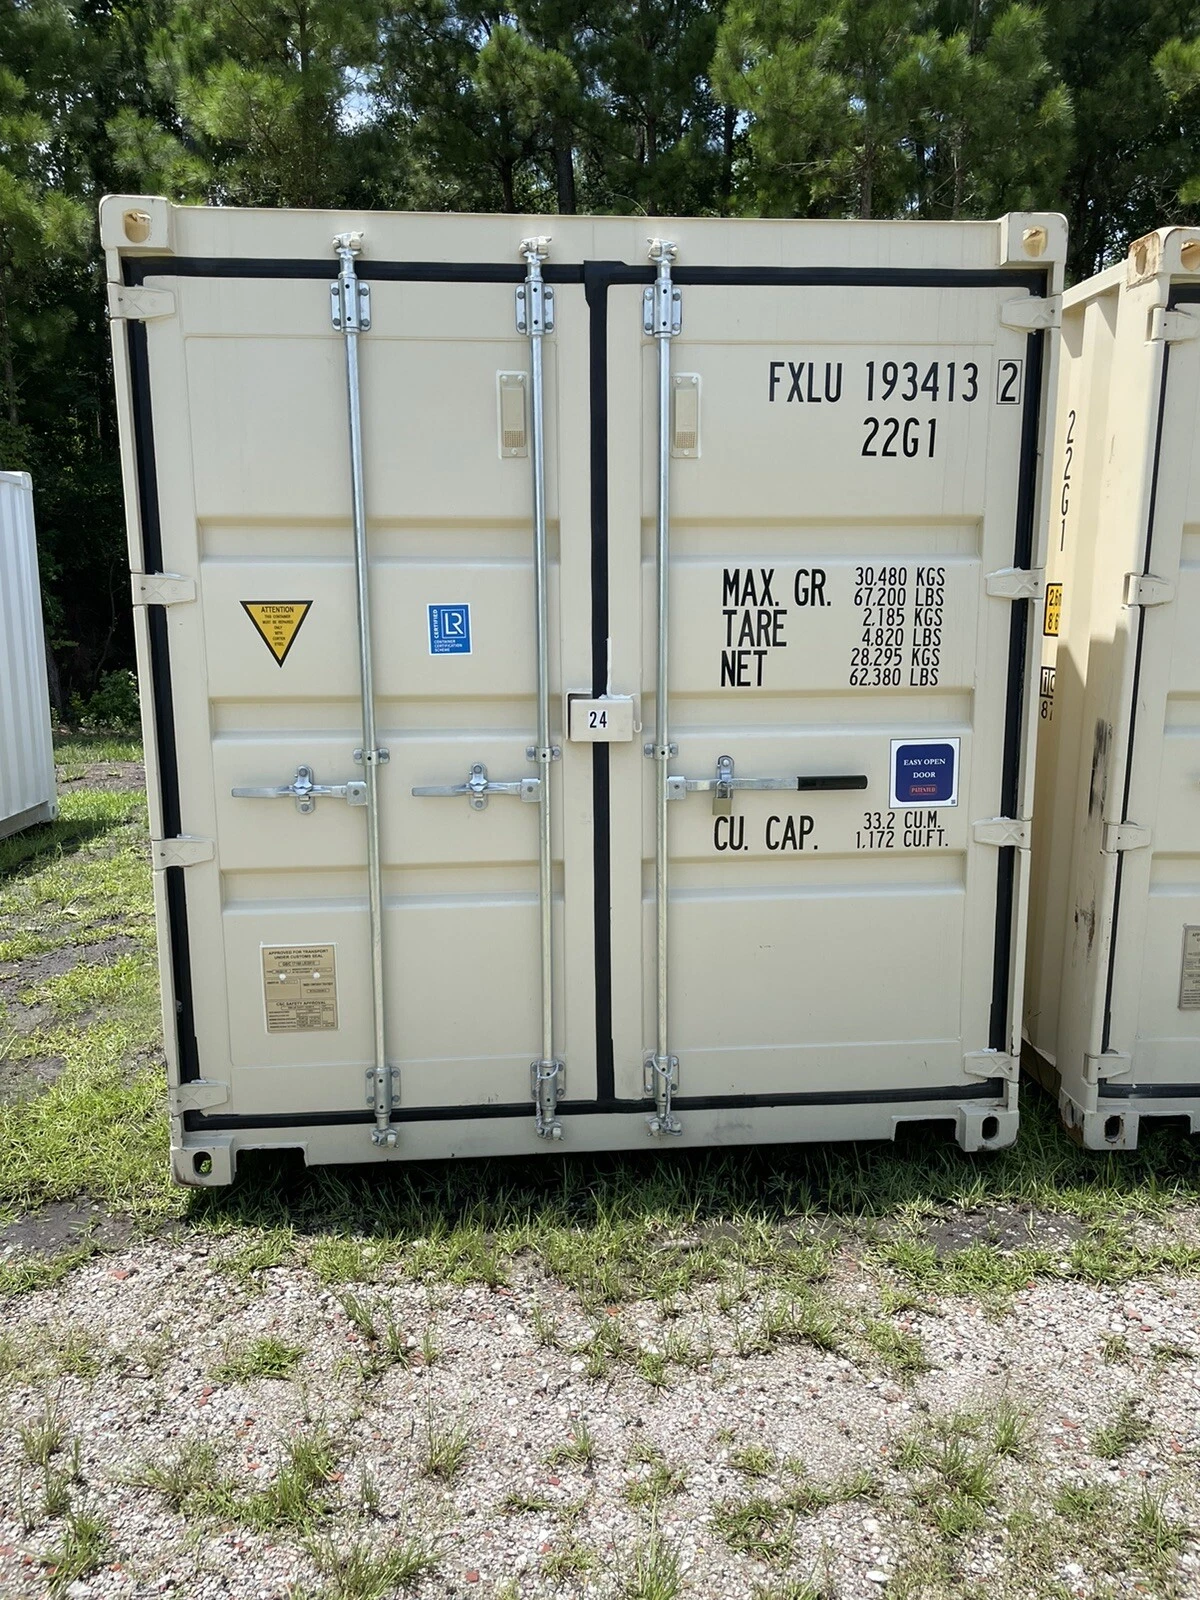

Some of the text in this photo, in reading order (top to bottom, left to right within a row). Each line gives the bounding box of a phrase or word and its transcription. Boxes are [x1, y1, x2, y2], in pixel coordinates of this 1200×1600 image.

[769, 361, 1018, 402] FXLU 193413 2
[861, 416, 936, 458] 22G1
[1061, 410, 1075, 551] 22G1
[916, 567, 945, 586] KGS
[722, 568, 831, 607] MAX. GR.
[915, 587, 944, 607] LBS
[445, 612, 464, 635] LR
[914, 608, 943, 627] KGS
[722, 610, 787, 647] TARE
[913, 628, 942, 647] LBS
[911, 648, 940, 667] KGS
[721, 650, 767, 687] NET
[910, 667, 939, 687] LBS
[590, 711, 607, 728] 24
[913, 771, 936, 779] DOOR
[863, 811, 941, 830] 33.2 CU.M.
[714, 815, 818, 850] CU. CAP.
